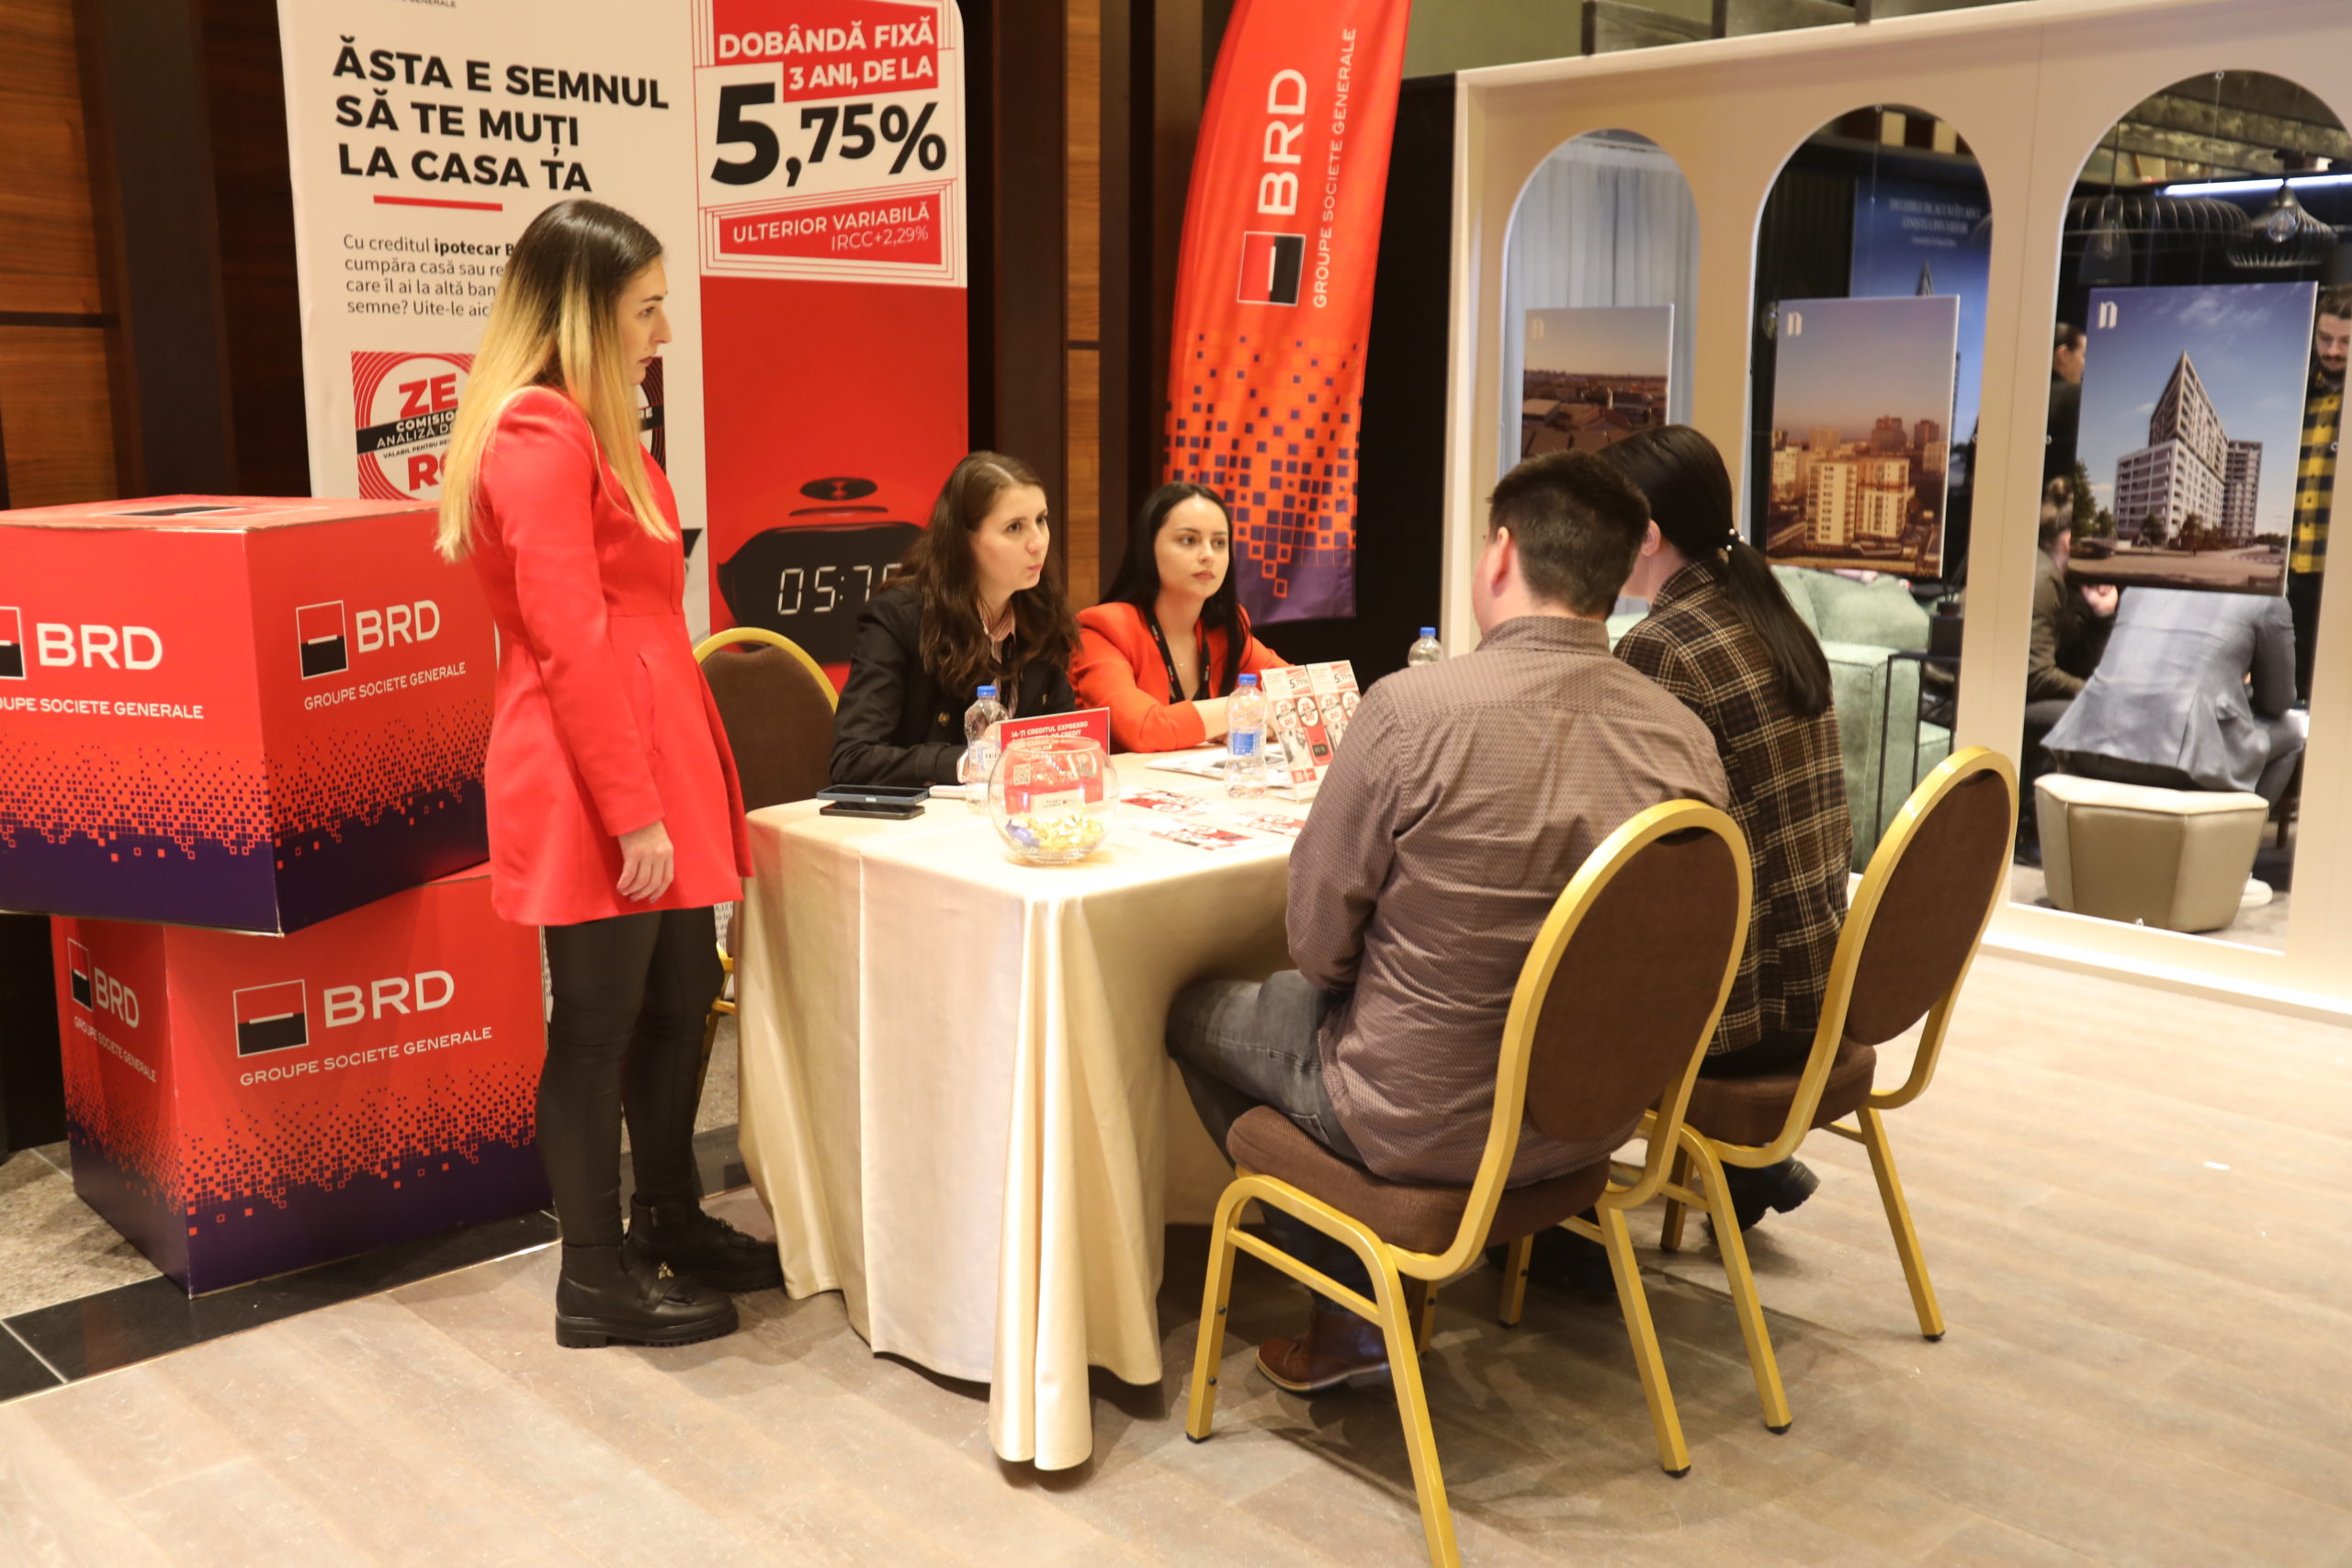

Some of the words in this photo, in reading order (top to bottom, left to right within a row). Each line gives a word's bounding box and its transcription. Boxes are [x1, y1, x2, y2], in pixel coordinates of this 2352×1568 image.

[718, 20, 866, 59] DOBÂNDĂ
[875, 16, 934, 49] FIXĂ
[333, 35, 454, 89] ĂSTA
[466, 60, 492, 92] E
[505, 64, 669, 109] SEMNUL
[788, 66, 804, 90] 3
[808, 62, 858, 89] ANI,
[864, 58, 896, 84] DE
[901, 55, 933, 80] LA
[1332, 28, 1357, 135] GENERALE
[335, 88, 399, 130] SĂ
[411, 101, 465, 137] TE
[479, 107, 579, 156] MUȚI
[710, 82, 946, 187] 5,75%
[1257, 68, 1307, 216] BRD
[338, 142, 399, 178] LA
[411, 150, 530, 189] CASA
[540, 159, 593, 193] TA
[1322, 140, 1343, 222] SOCIETE
[344, 234, 364, 250] Cu
[368, 236, 430, 253] creditul
[434, 238, 502, 256] ipotecar
[733, 217, 827, 243] ULTERIOR
[832, 201, 930, 230] VARIABILĂ
[831, 224, 929, 252] IRCC+2,29%
[345, 257, 415, 276] cumpăra
[420, 260, 455, 275] casă
[459, 264, 485, 276] sau
[490, 264, 504, 276] re
[346, 279, 380, 292] care
[384, 277, 393, 293] îl
[399, 279, 412, 293] ai
[416, 278, 430, 294] la
[435, 280, 464, 297] altă
[468, 281, 496, 297] ban
[1313, 227, 1332, 309] GROUPE
[347, 299, 408, 315] semne?
[413, 300, 464, 316] Uite-le
[396, 411, 456, 433] COMISIO
[383, 448, 411, 459] VALABIL
[412, 442, 438, 453] PENTRU
[408, 453, 448, 491] R
[36, 622, 164, 671] BRD
[355, 599, 441, 654] BRD
[0, 696, 37, 711] UPE
[40, 699, 111, 716] SOCIETE
[113, 702, 205, 720] GENERALE
[304, 686, 357, 711] GROUPE
[358, 675, 409, 699] SOCIETE
[410, 660, 467, 687] GENERALE
[1027, 726, 1057, 735] CREDITUL
[1057, 721, 1089, 731] EXPRESSO
[94, 966, 140, 1029] BRD
[322, 969, 455, 1029] BRD
[240, 1060, 320, 1087] GROUPE
[323, 1044, 400, 1071] SOCIETE
[402, 1026, 493, 1055] GENERALE
